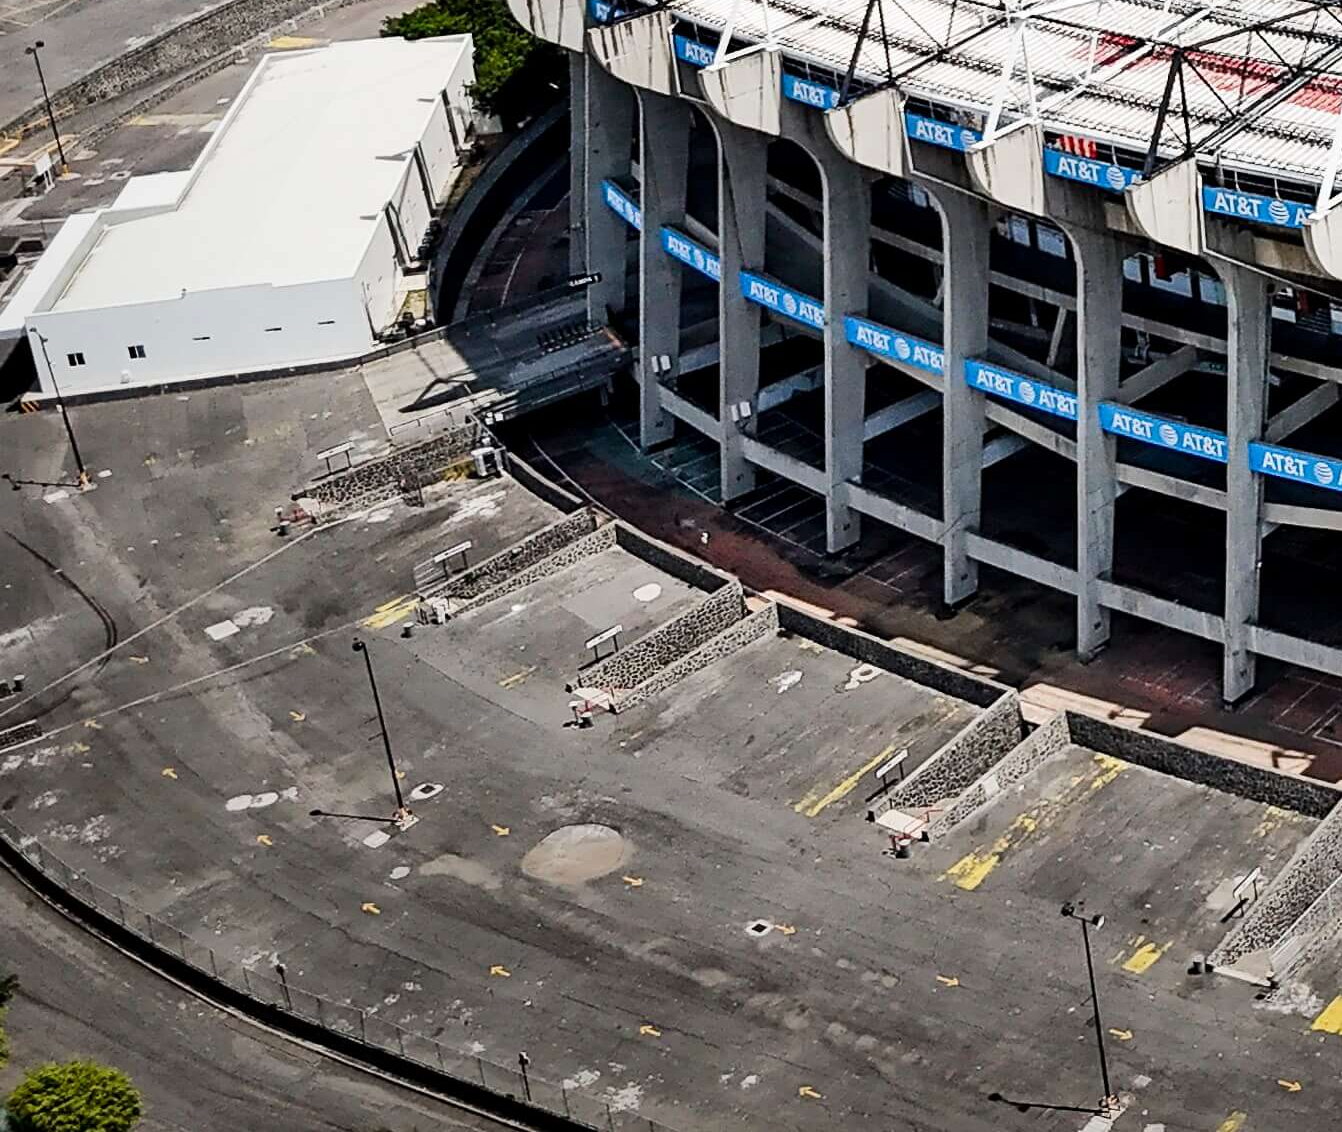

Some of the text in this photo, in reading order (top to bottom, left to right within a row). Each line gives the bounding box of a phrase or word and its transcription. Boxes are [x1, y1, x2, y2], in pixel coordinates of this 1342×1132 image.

[793, 82, 824, 104] AT&T
[917, 122, 954, 145] AT&T
[1059, 158, 1100, 181] AT&T
[1215, 190, 1261, 216] AT&T
[750, 281, 779, 306] AT&T
[856, 326, 891, 351] AT&T
[978, 371, 1078, 416] AT&T AT&T
[1113, 414, 1224, 455] AT&T AT&T
[1263, 452, 1307, 476] AT&T
